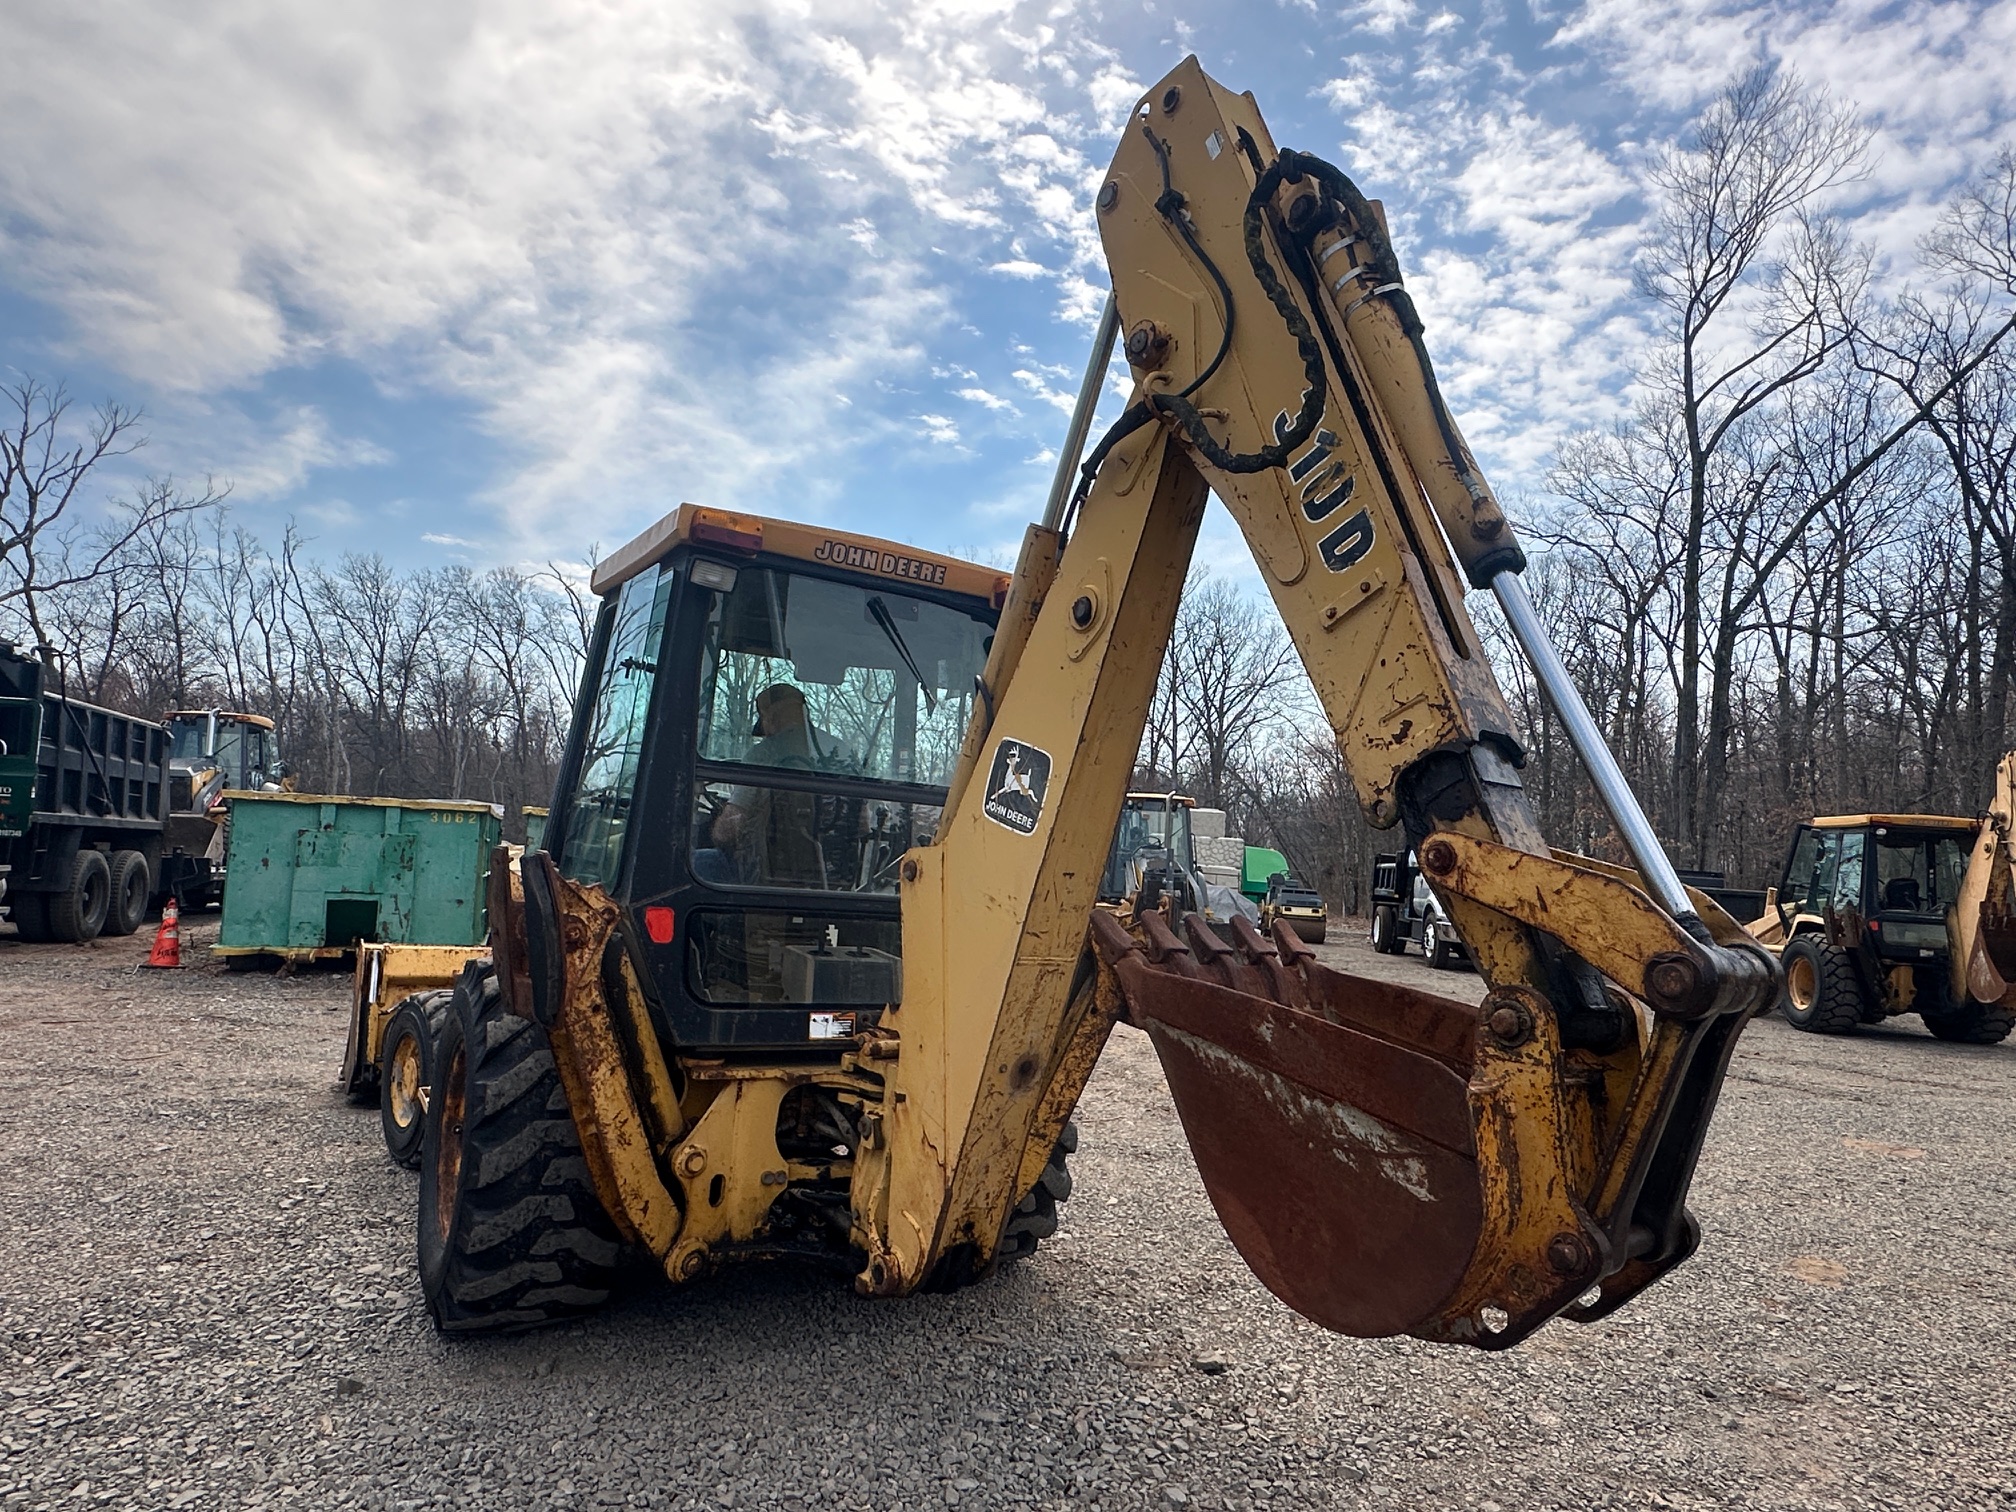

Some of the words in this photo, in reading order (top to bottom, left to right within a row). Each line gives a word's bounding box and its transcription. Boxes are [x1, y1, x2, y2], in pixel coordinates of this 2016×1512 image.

[815, 540, 879, 571] JOHN
[881, 553, 947, 585] DEERE
[430, 811, 477, 824] 3062
[986, 801, 1006, 817] JOHN
[1006, 807, 1033, 829] DEERE
